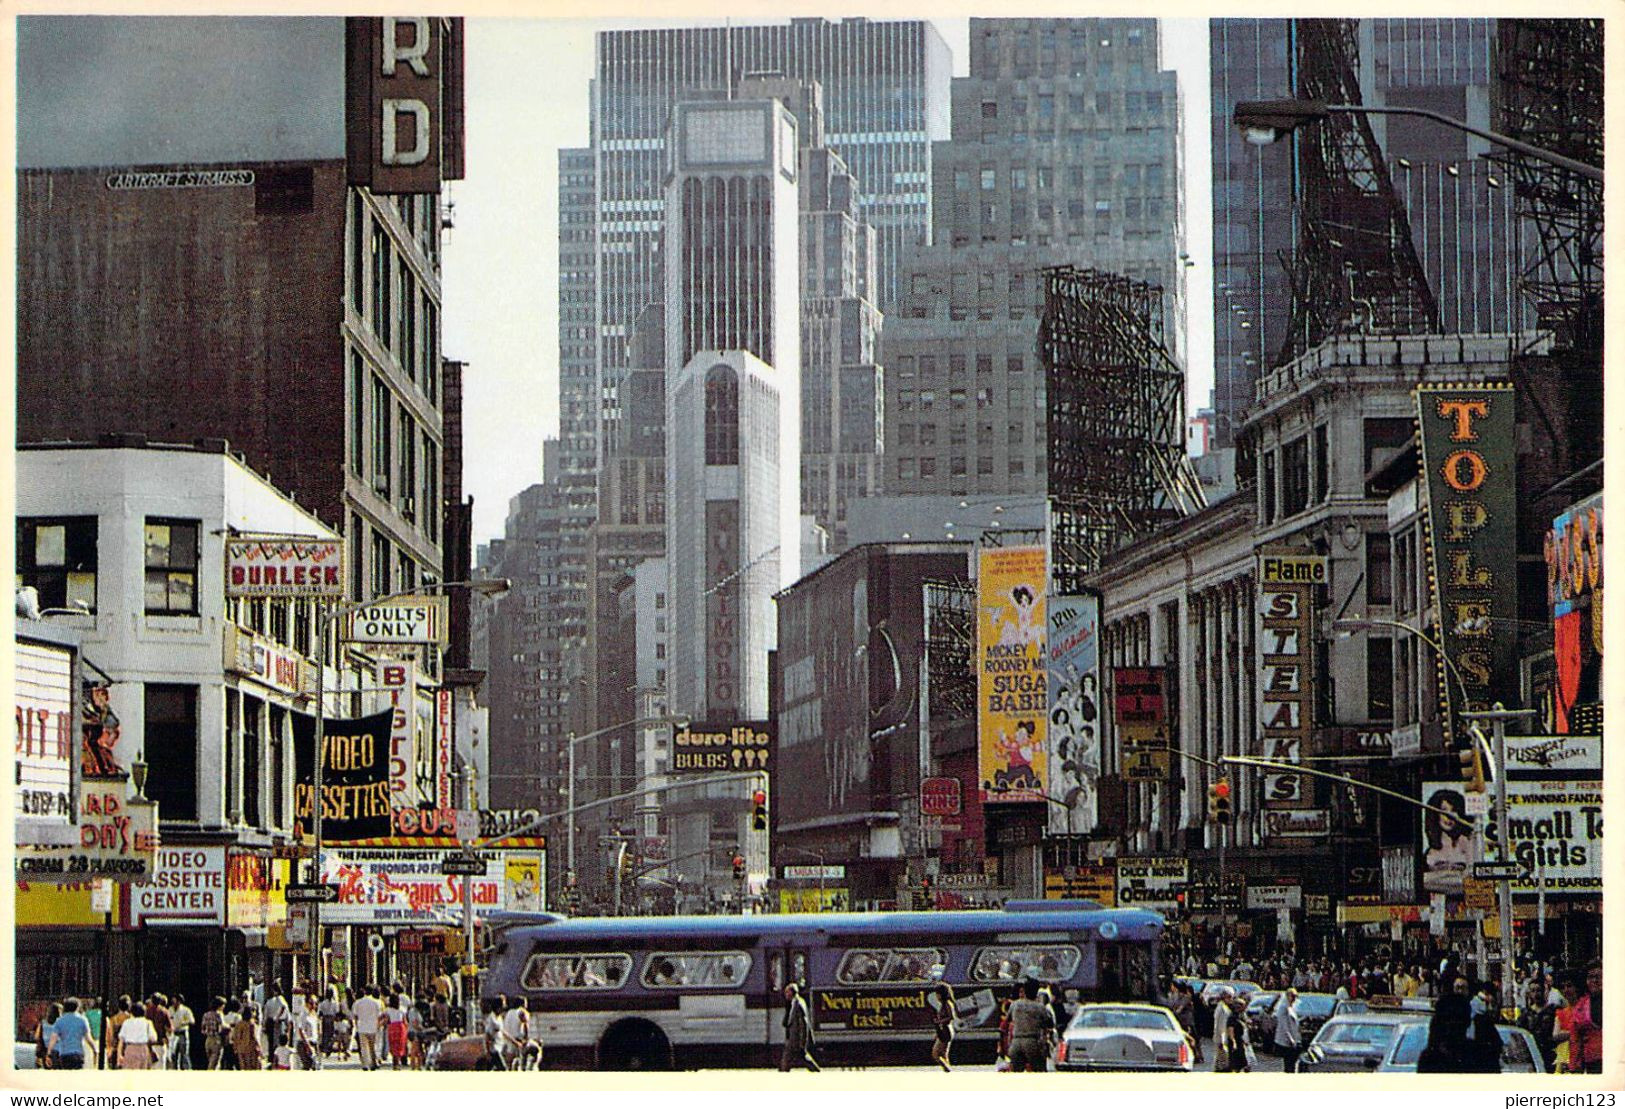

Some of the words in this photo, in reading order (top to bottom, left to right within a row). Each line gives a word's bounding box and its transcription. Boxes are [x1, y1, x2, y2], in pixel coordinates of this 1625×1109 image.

[113, 173, 184, 188] ARTKRAFT
[187, 172, 249, 186] STRAUSS
[231, 565, 340, 586] BURLESK
[1263, 558, 1325, 581] Flame
[356, 606, 426, 622] ADULTS
[365, 621, 417, 637] ONLY
[984, 658, 1029, 673] ROONEY
[1267, 593, 1297, 800] STEAKS
[676, 752, 728, 768] BULBS
[295, 781, 391, 821] CASSETTES
[397, 851, 438, 861] FAWCETT
[1514, 840, 1588, 870] Girls
[936, 873, 989, 887] FORUM
[141, 892, 214, 909] CENTER
[1120, 886, 1177, 903] OCTAGO
[820, 992, 852, 1010] New
[855, 991, 926, 1014] improved
[852, 1012, 894, 1028] taste!
